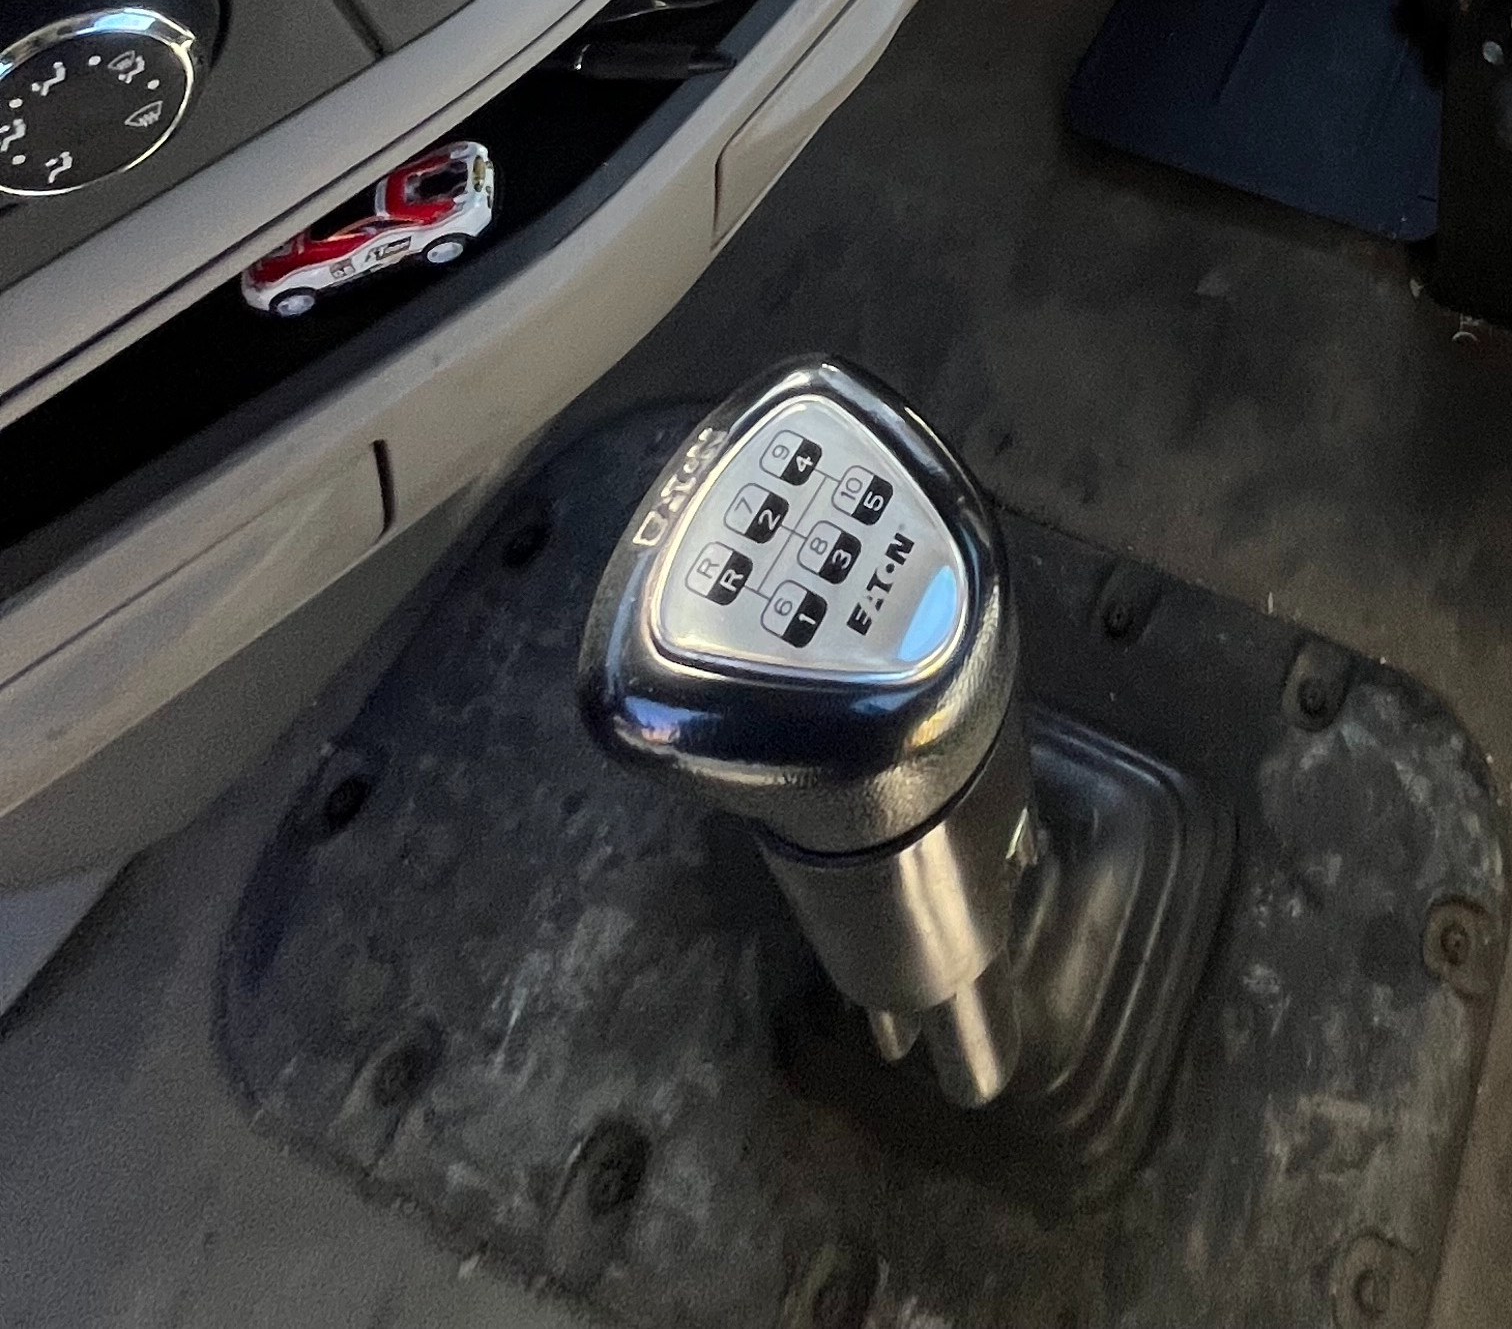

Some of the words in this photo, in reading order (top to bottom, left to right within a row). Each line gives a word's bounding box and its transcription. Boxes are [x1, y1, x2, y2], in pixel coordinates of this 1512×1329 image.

[771, 444, 790, 460] 9
[796, 455, 814, 473] 4
[841, 477, 864, 501] 10
[734, 496, 753, 515] 7
[863, 491, 885, 512] 5
[758, 509, 782, 531] 2
[809, 536, 829, 556] 8
[696, 557, 721, 580] R
[831, 548, 853, 570] 3
[719, 568, 745, 593] R
[773, 597, 793, 617] 6
[798, 612, 817, 626] 1
